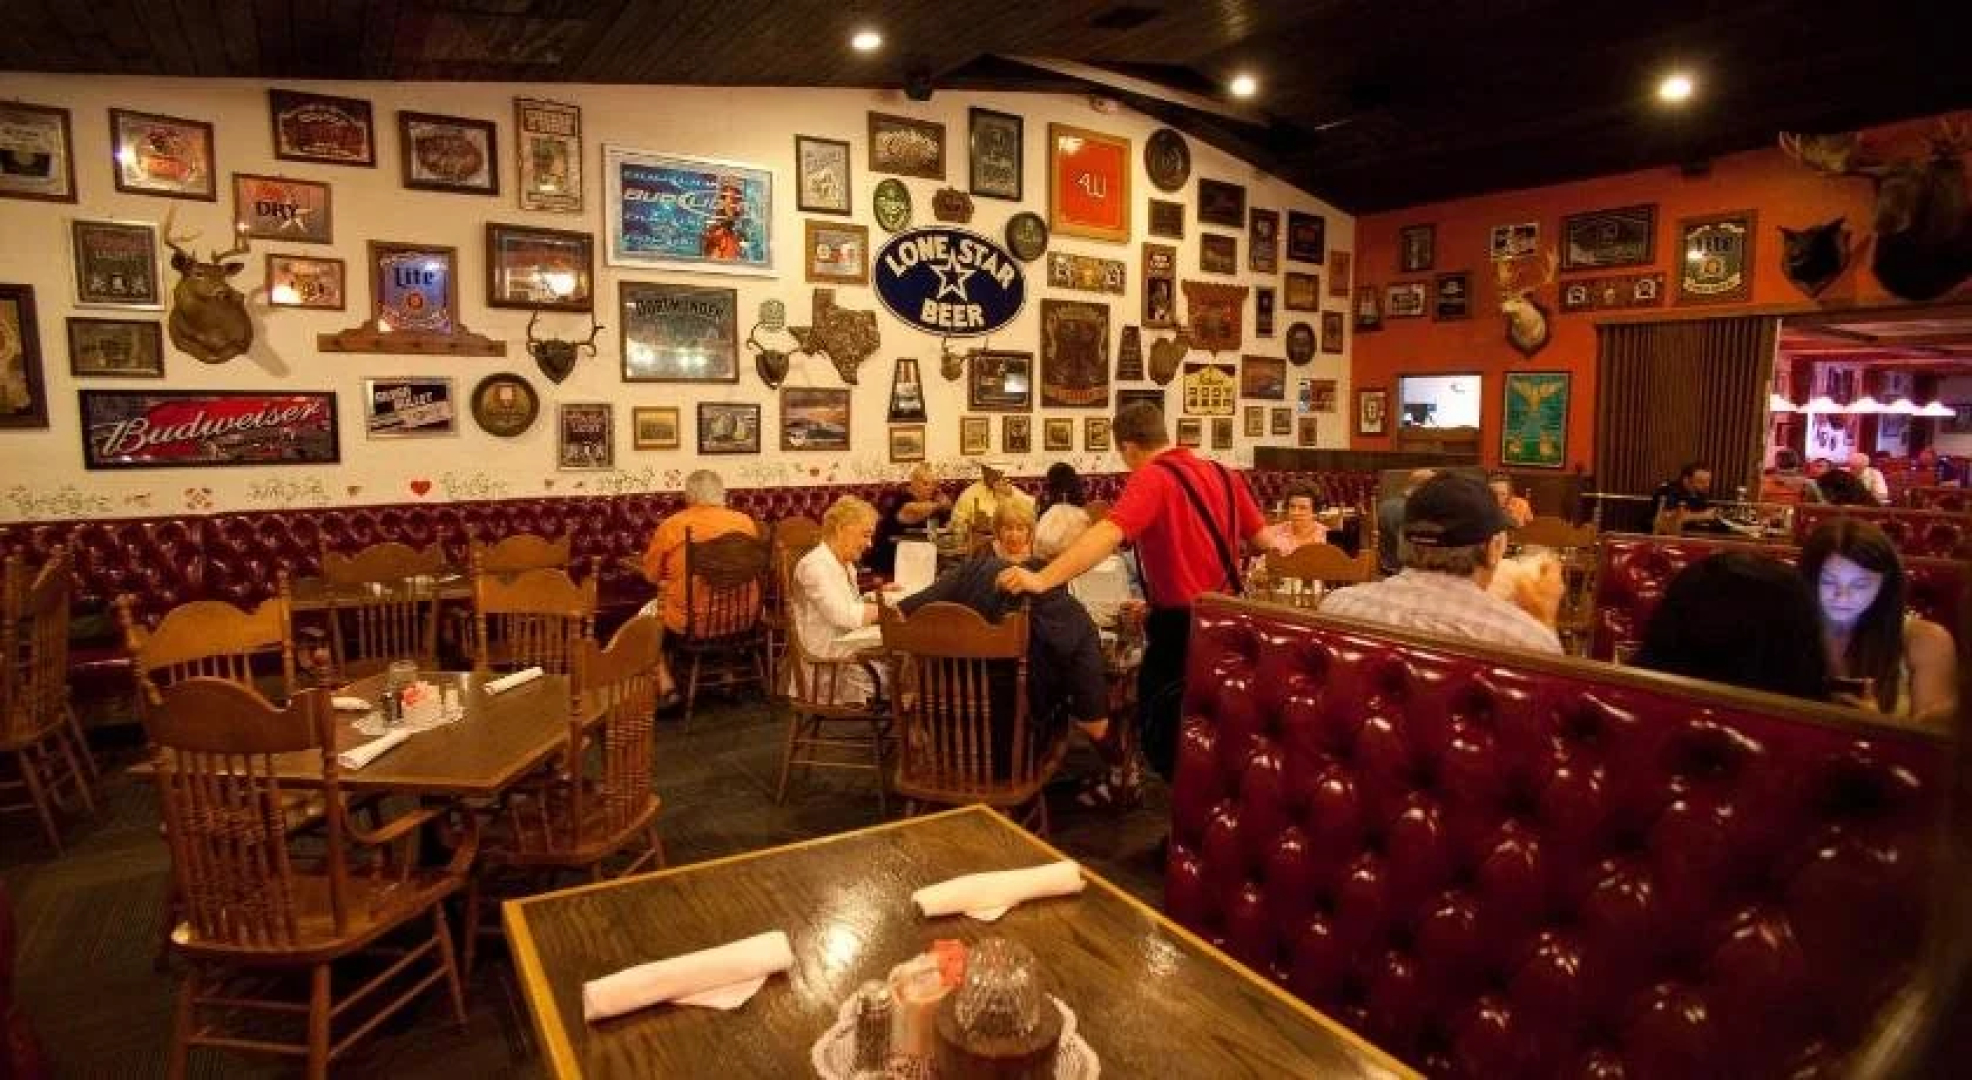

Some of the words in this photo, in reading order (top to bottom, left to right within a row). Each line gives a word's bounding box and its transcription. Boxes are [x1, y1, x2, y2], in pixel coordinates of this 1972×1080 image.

[256, 201, 299, 220] DRY
[394, 267, 434, 288] Lite
[884, 236, 949, 278] LONE
[957, 238, 1015, 290] STAR
[920, 298, 985, 327] BEER
[93, 400, 320, 456] Budweiser
